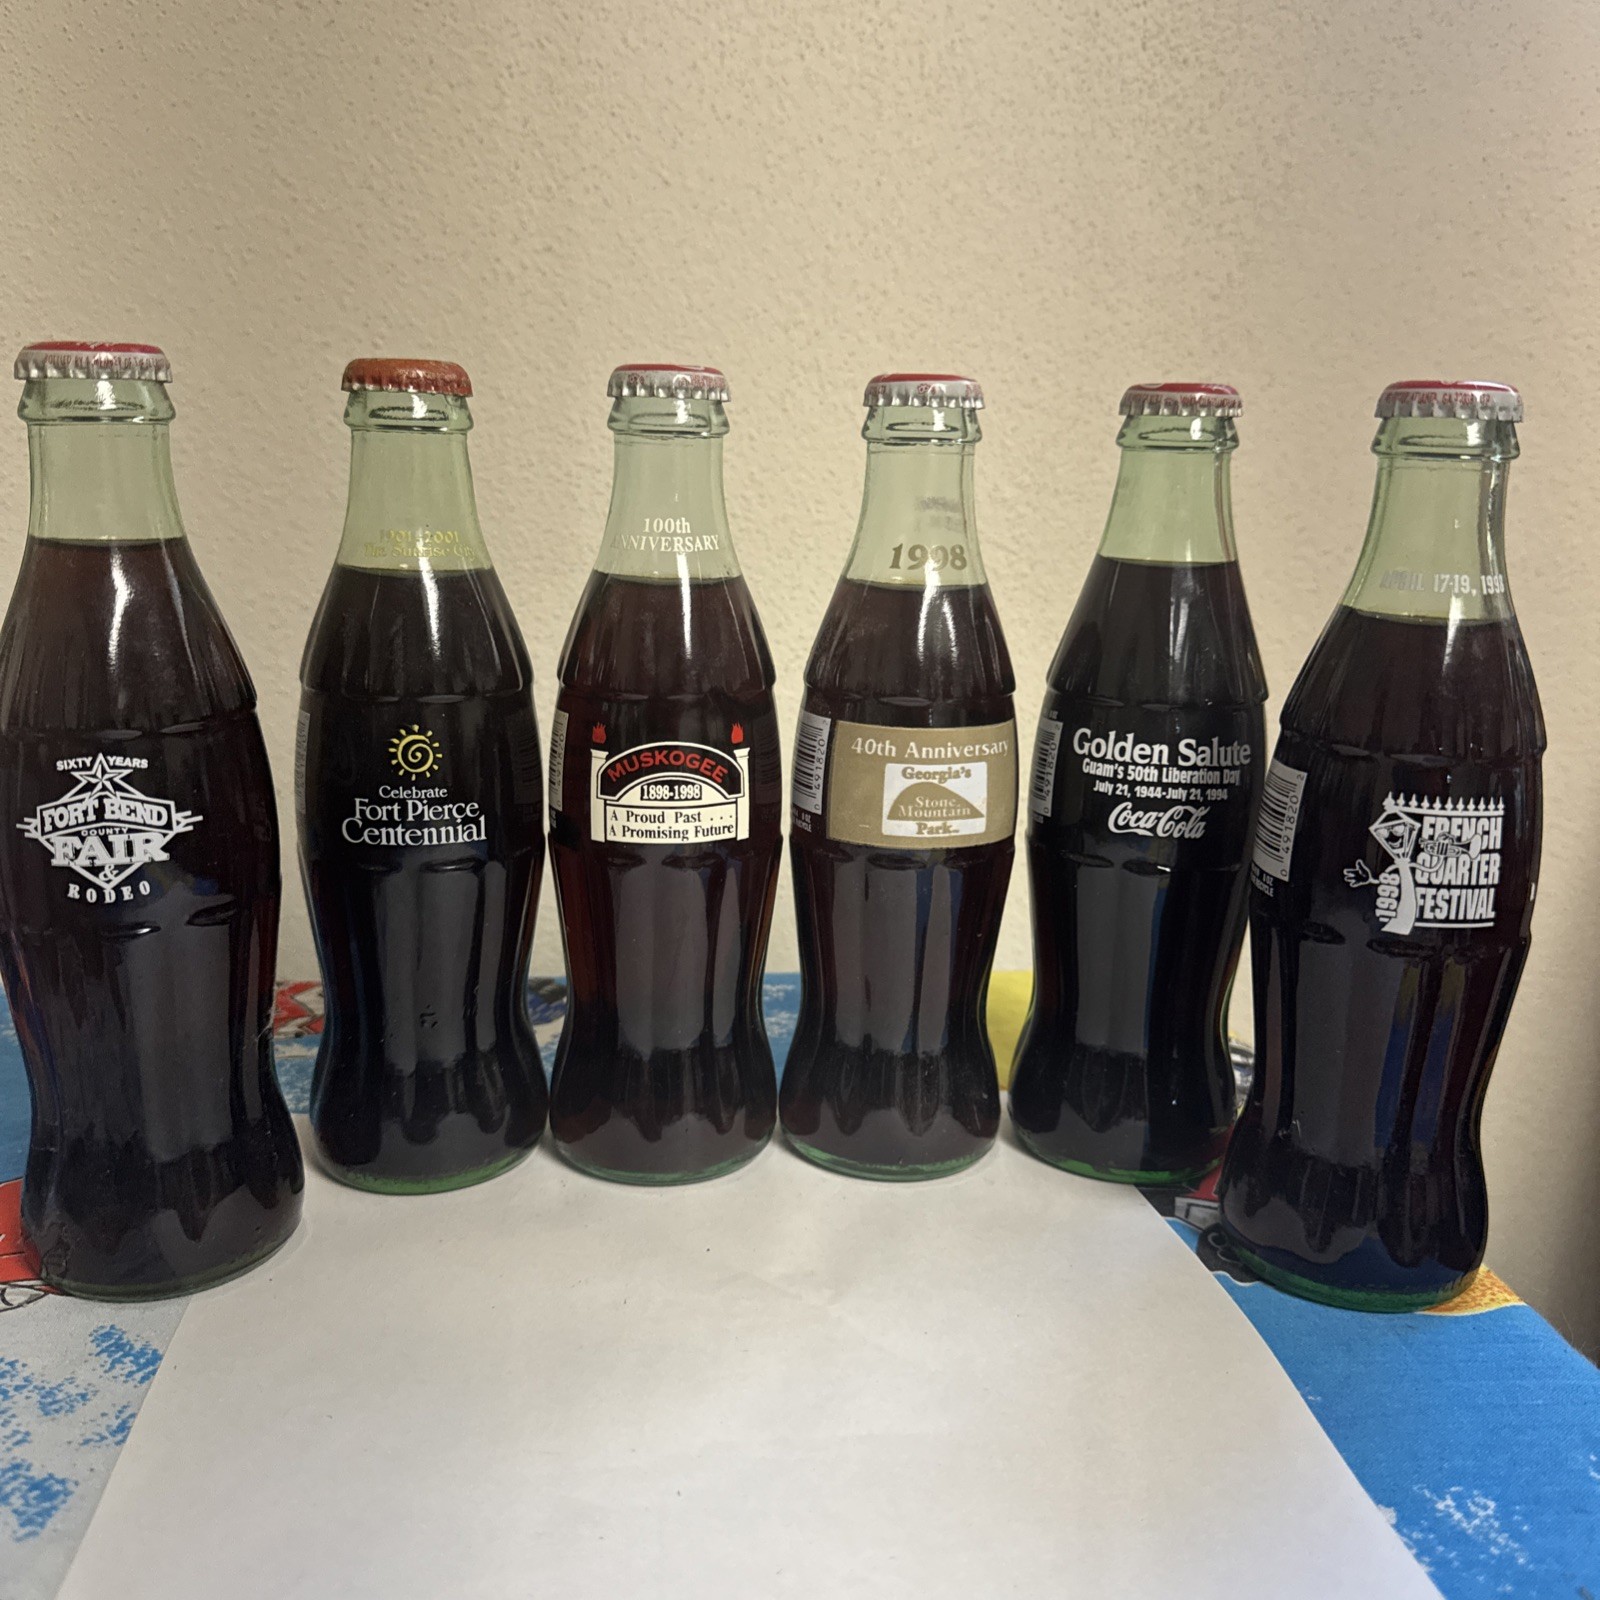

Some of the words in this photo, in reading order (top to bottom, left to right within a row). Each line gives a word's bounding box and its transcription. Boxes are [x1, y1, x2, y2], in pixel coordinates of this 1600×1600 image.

[643, 517, 691, 534] 100th
[889, 543, 968, 571] 1998
[851, 737, 897, 758] 40th
[904, 739, 1009, 759] Anniversary
[1072, 728, 1169, 766] Golden
[1178, 736, 1252, 767] Salute
[56, 755, 94, 771] SIXTY
[106, 755, 149, 769] YEARS
[607, 750, 729, 783] MUSKOGEE
[901, 766, 972, 784] Georgia's
[1082, 758, 1124, 779] Guam's
[1127, 765, 1159, 782] 50th
[1162, 766, 1221, 785] Liberation
[1222, 769, 1241, 787] Day
[379, 785, 448, 799] Celebrate
[642, 784, 701, 800] 1898-1998
[1093, 780, 1114, 796] July
[1115, 783, 1131, 798] 21,
[1134, 785, 1188, 801] 1944-July
[1189, 788, 1203, 802] 21,
[1205, 788, 1228, 801] 1994
[42, 798, 99, 833] FORT
[103, 798, 168, 827] BEND
[354, 797, 402, 821] Fort
[406, 799, 481, 821] Pierce
[610, 809, 618, 822] A
[626, 810, 665, 824] Proud
[674, 810, 702, 823] Past
[898, 804, 972, 818] Mountain
[1107, 801, 1211, 839] Coca-Cola
[80, 826, 129, 837] COUNTY
[341, 814, 488, 847] Centennial
[609, 824, 617, 837] A
[621, 824, 689, 842] Promising
[694, 823, 735, 838] Future
[49, 831, 170, 867] FAIR
[98, 863, 118, 882] &
[1414, 852, 1501, 887] QUARTER
[67, 879, 151, 904] RODEO
[1375, 871, 1400, 918] 1998
[1415, 886, 1497, 920] FESTIVAL
